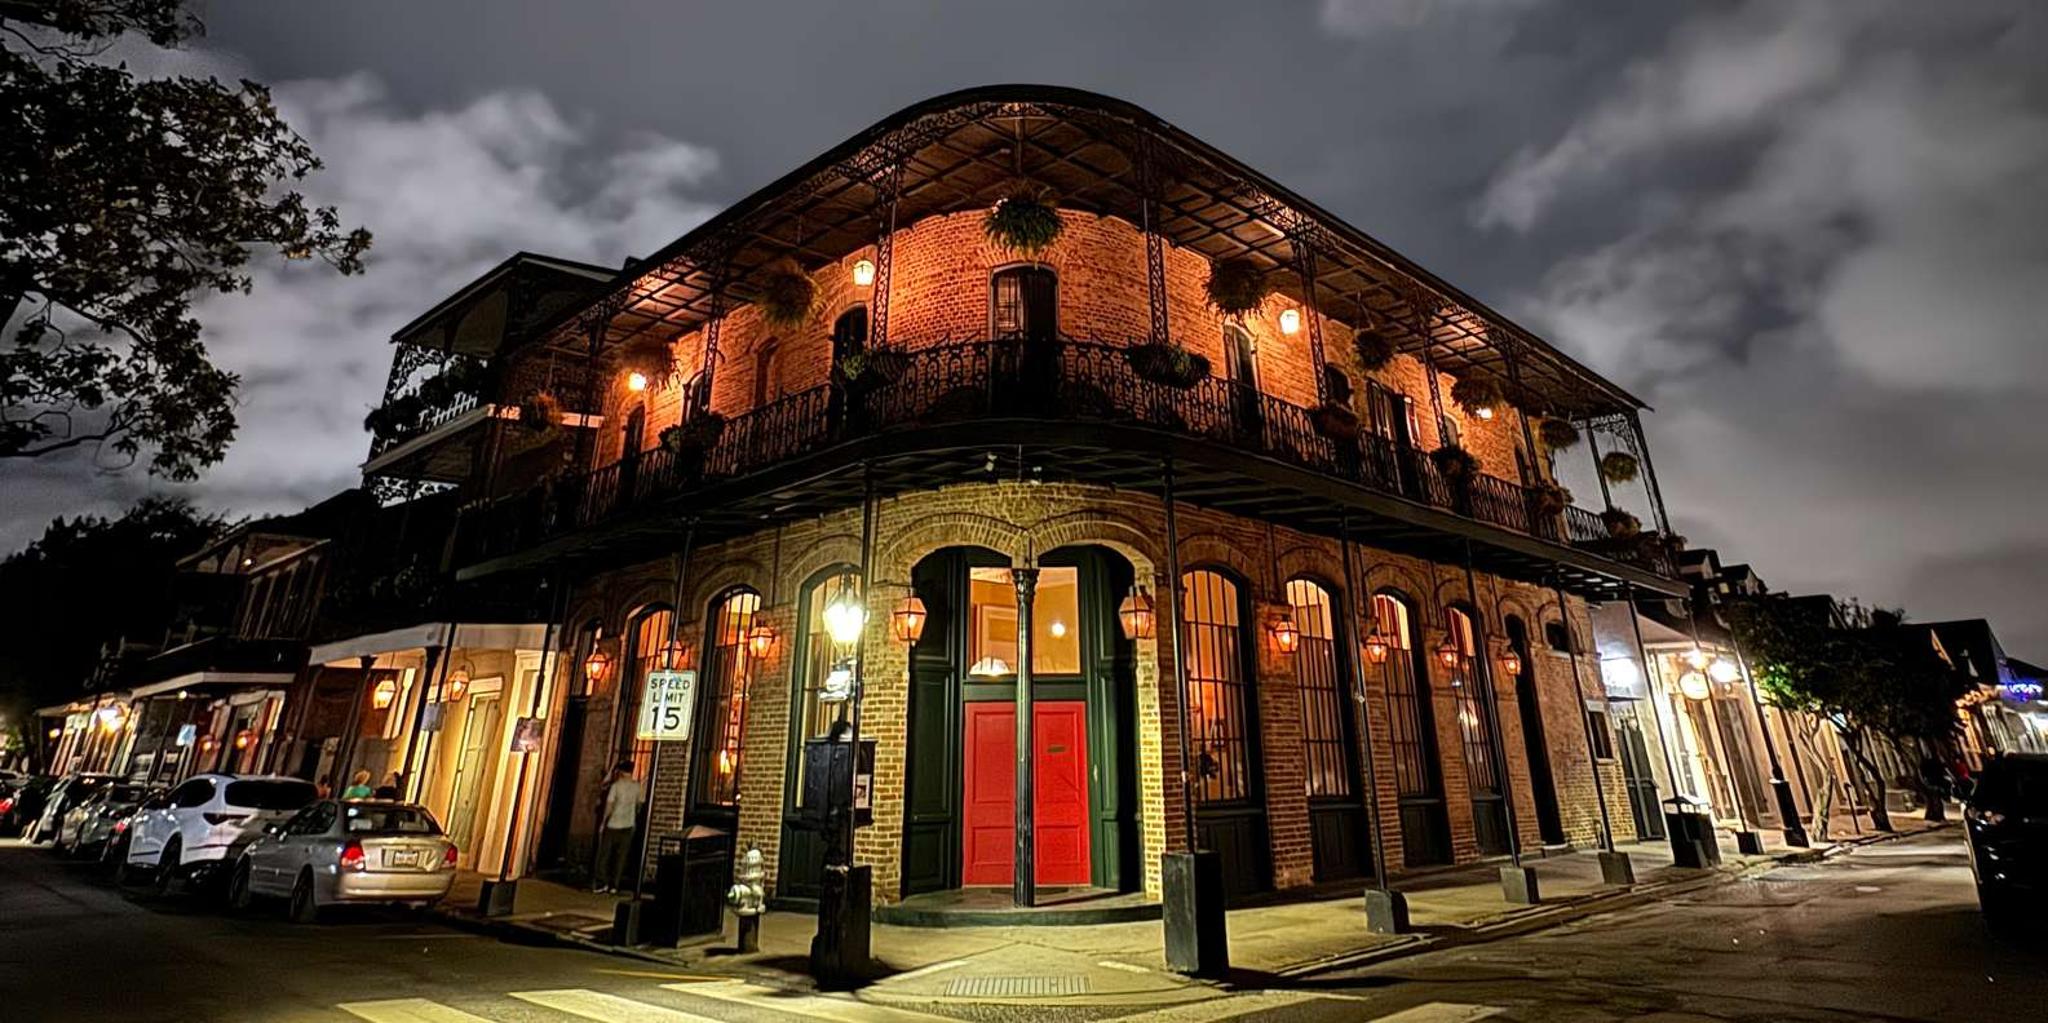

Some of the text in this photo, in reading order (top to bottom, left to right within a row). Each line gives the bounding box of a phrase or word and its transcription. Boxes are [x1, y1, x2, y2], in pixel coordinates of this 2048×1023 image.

[651, 678, 690, 689] SPEED
[652, 692, 684, 703] LMIT
[652, 706, 681, 731] 15
